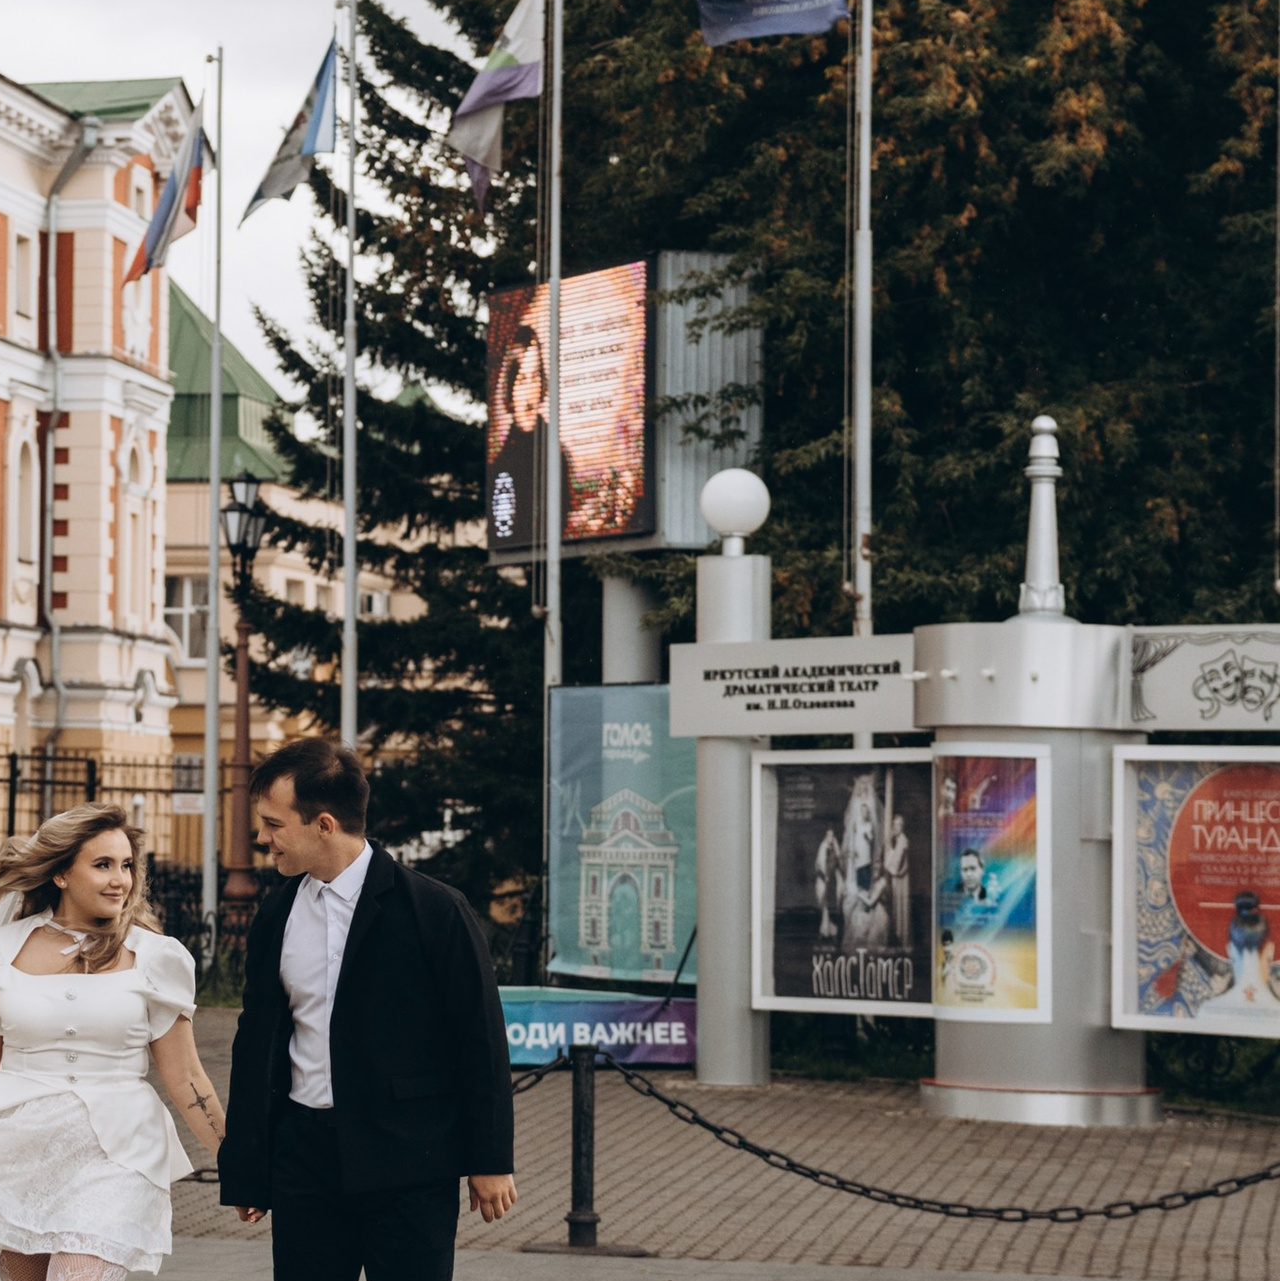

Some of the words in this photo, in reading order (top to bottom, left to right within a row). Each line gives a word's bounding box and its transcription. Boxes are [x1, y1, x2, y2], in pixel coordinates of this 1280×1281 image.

[703, 665, 779, 681] ИРКУТСКИЙ
[783, 660, 901, 678] АКАДЕМИЧЕСКИЙ
[723, 680, 835, 697] ДРАМАТИЧЕСКИЙ
[839, 680, 879, 692] ТЕАТР
[573, 1022, 687, 1045] ВАЖНЕЕ
